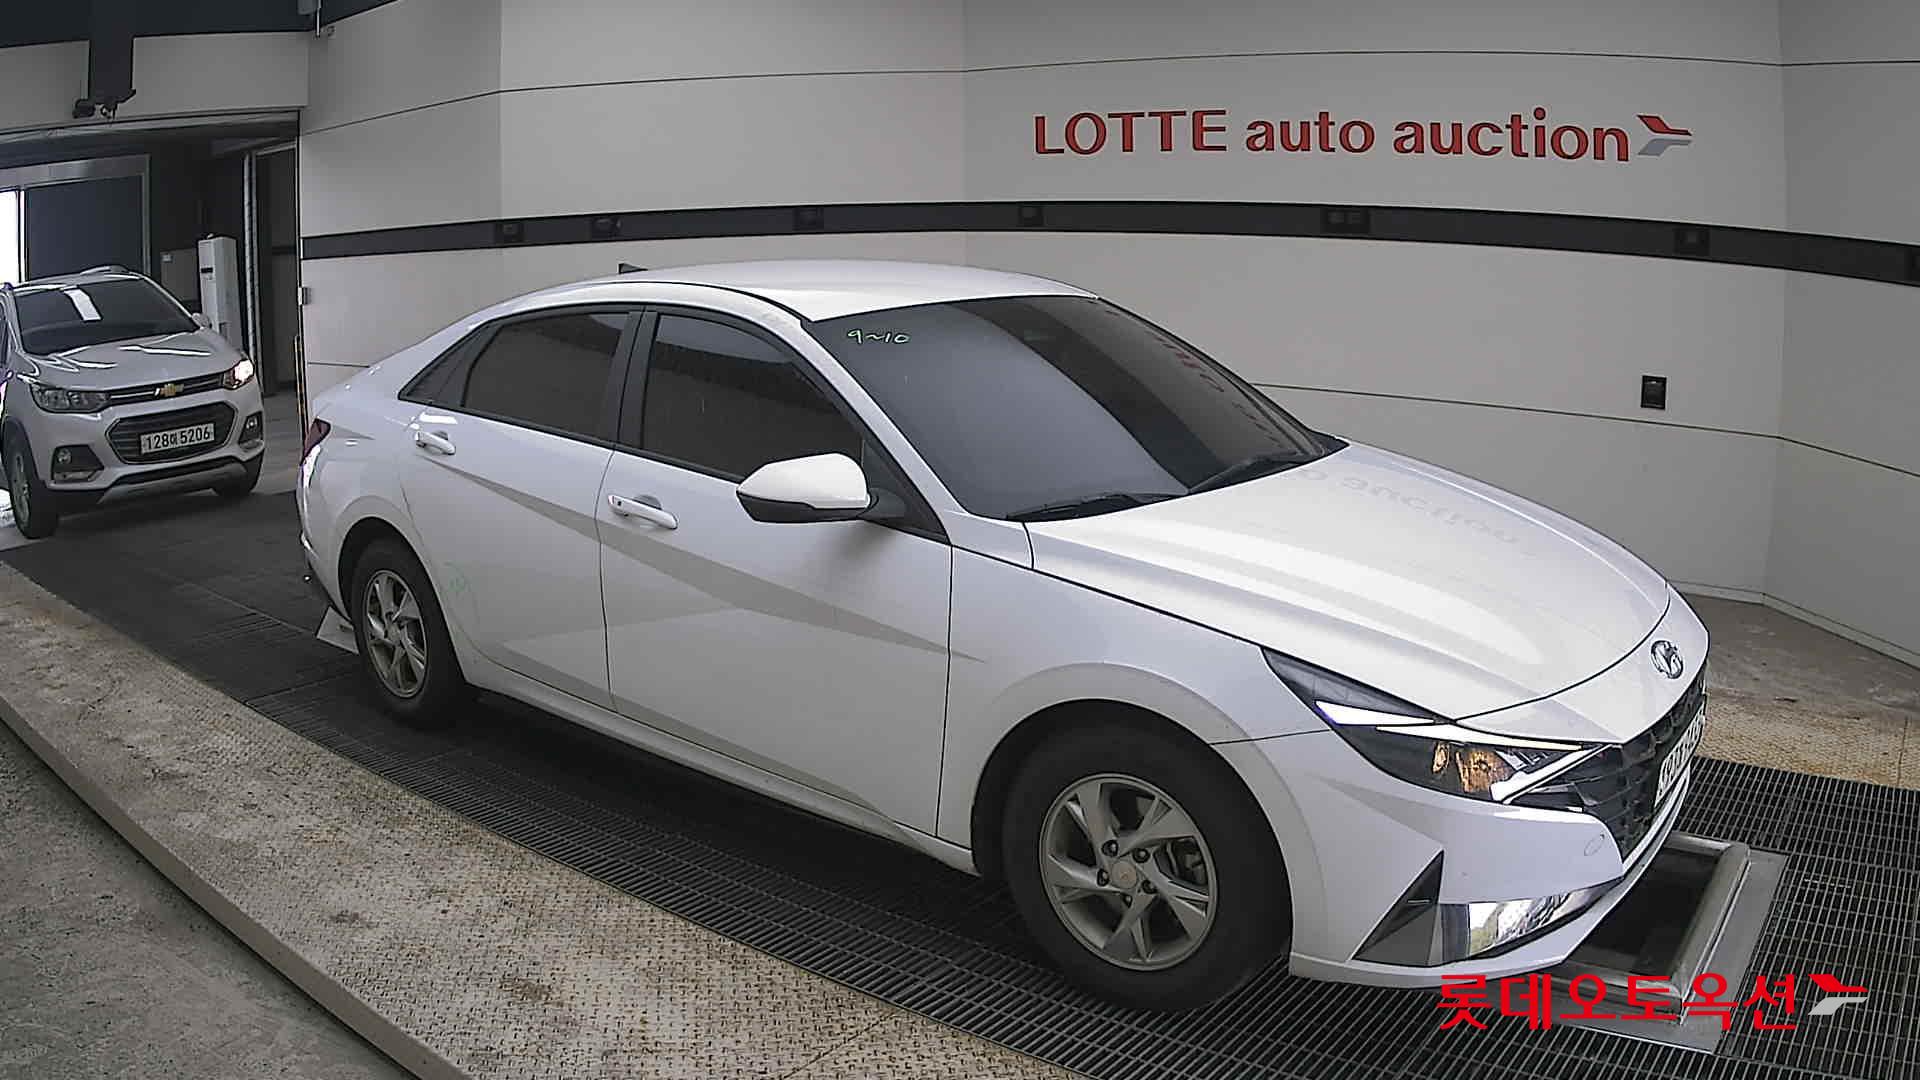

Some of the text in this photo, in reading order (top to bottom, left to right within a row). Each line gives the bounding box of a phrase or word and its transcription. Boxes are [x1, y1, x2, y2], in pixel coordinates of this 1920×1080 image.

[1034, 107, 1630, 162] LOTTE auto auction
